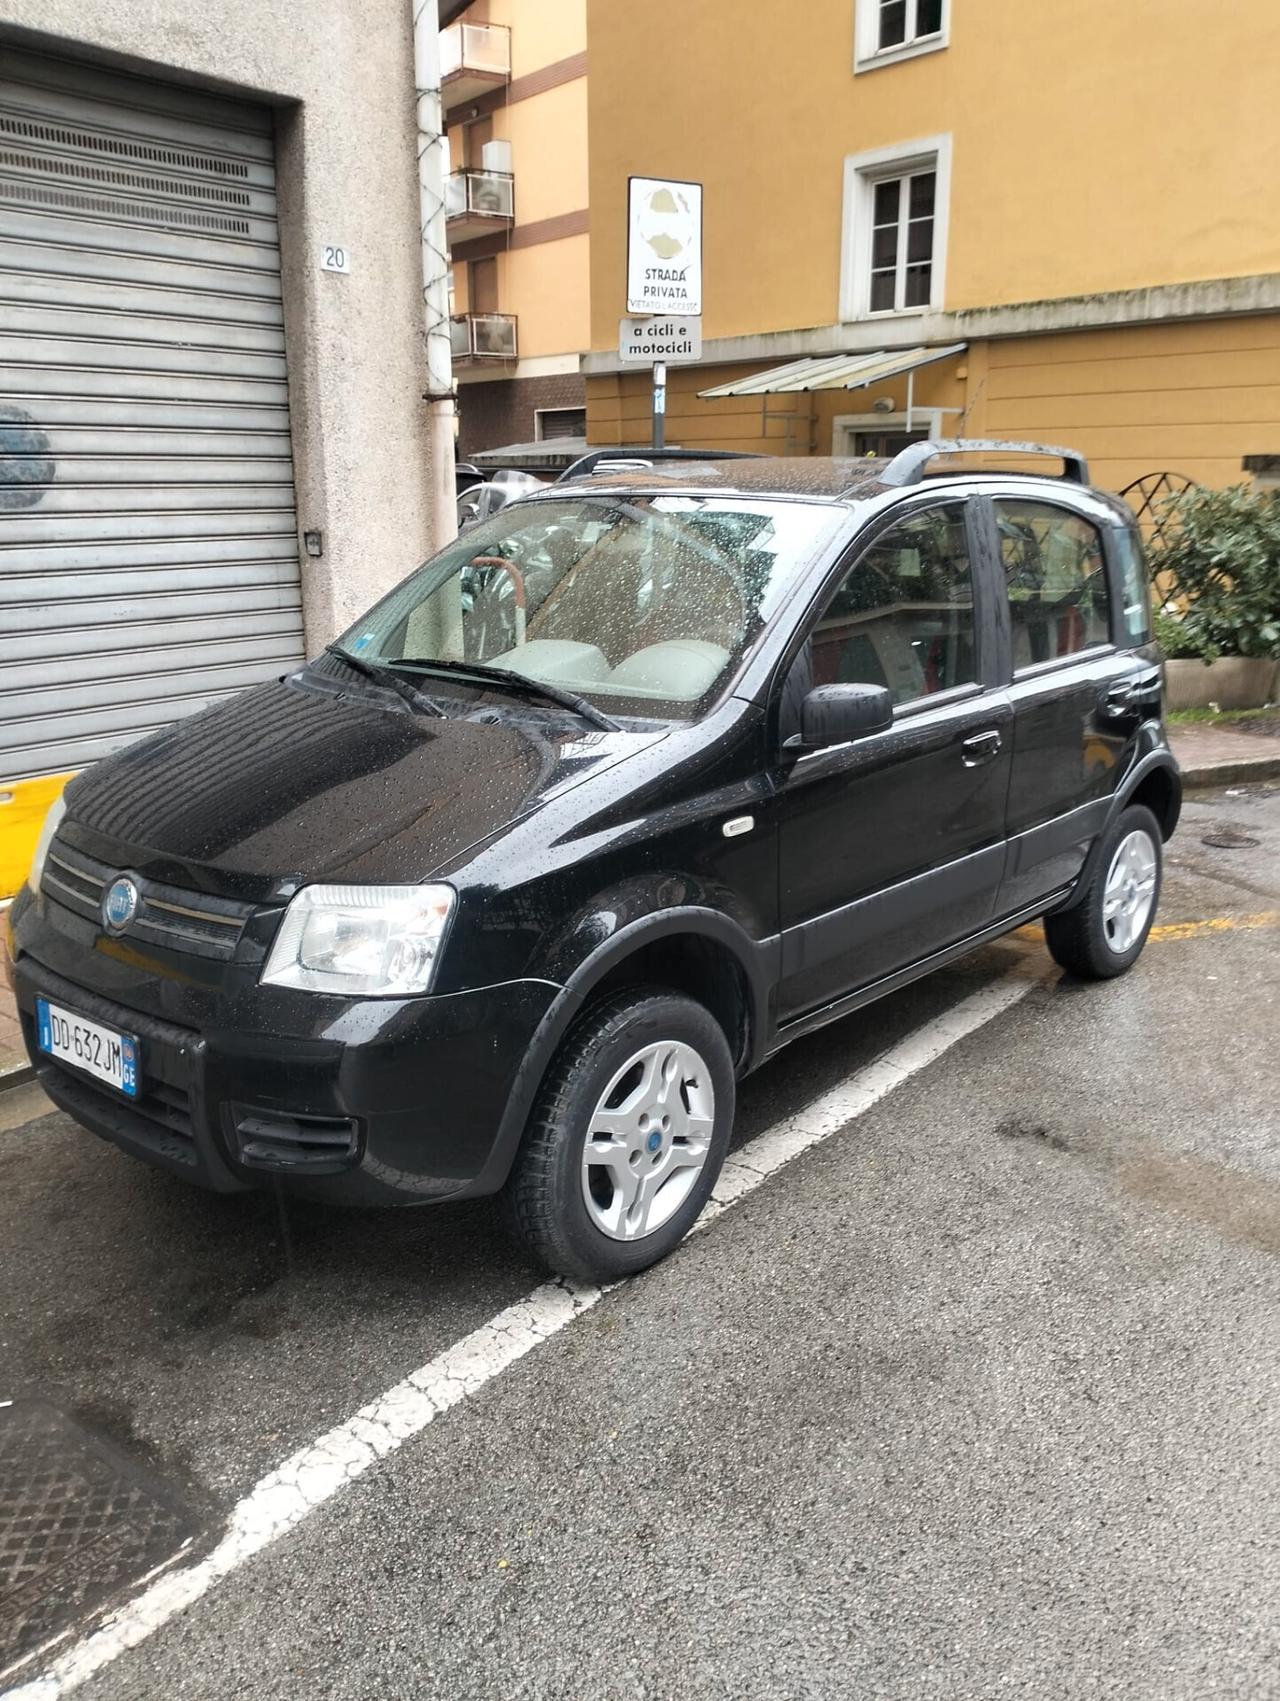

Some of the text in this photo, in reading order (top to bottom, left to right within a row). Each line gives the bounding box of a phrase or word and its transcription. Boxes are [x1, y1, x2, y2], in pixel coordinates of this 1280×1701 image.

[326, 247, 344, 268] 20
[645, 268, 687, 281] STRADA
[643, 285, 688, 298] PRIVATA
[633, 324, 687, 336] a cicli e
[629, 341, 692, 353] motocicli
